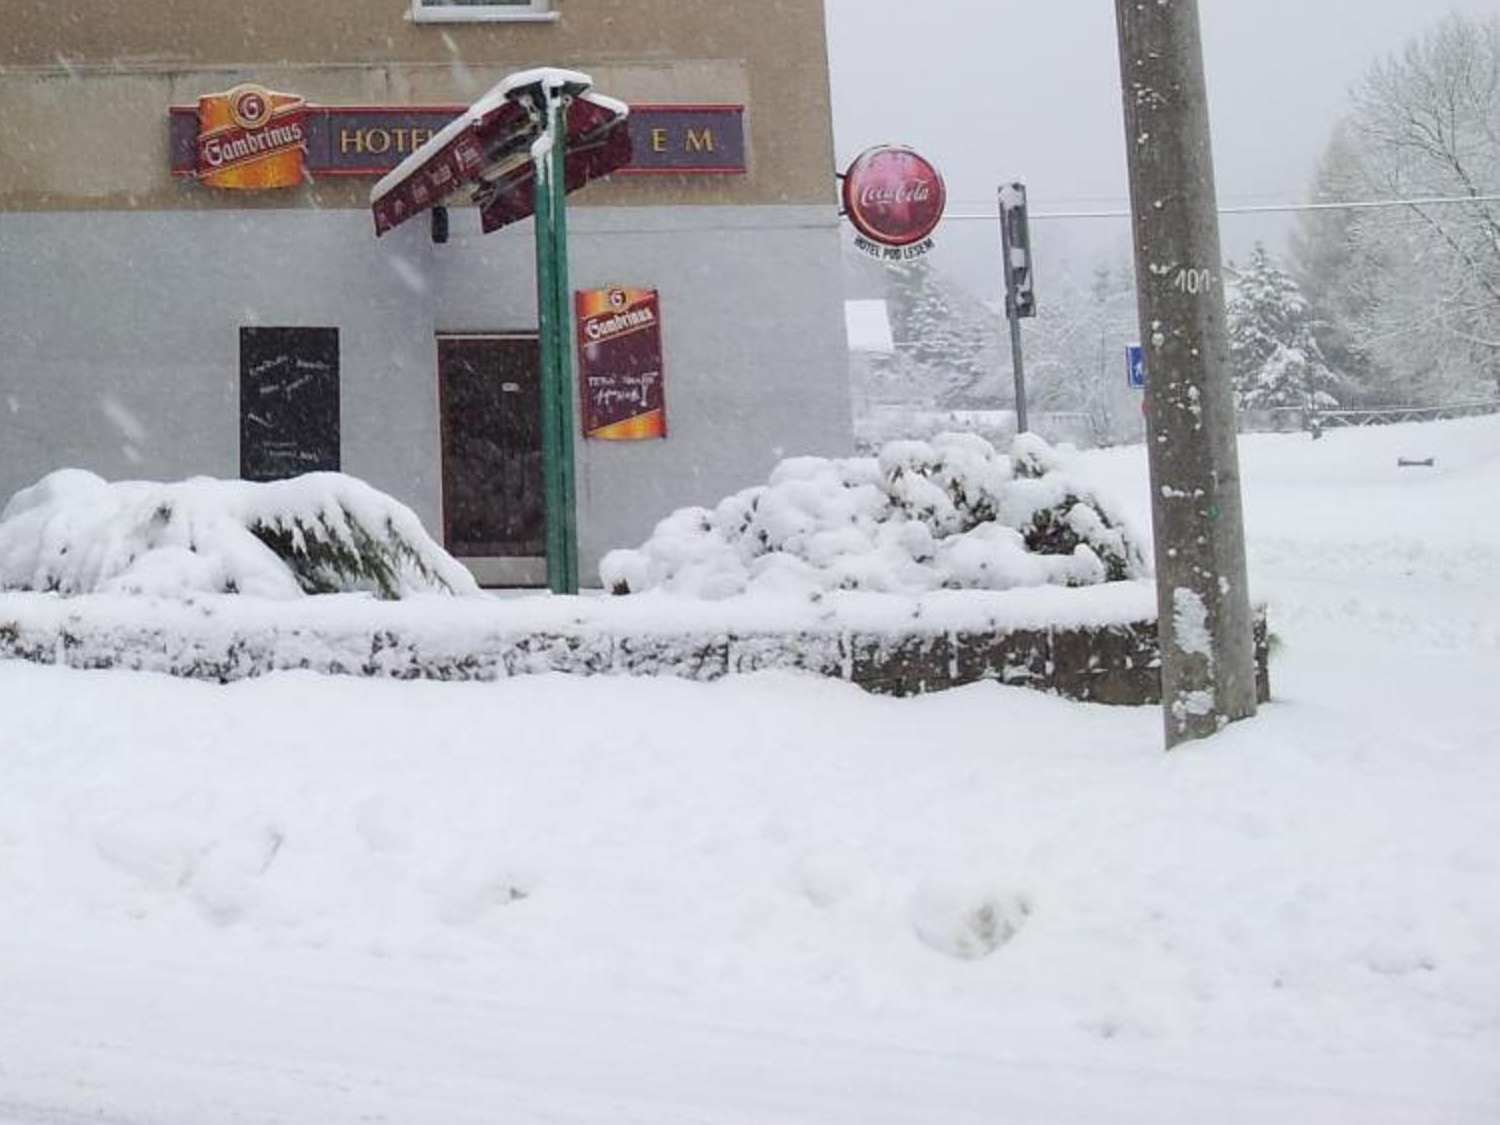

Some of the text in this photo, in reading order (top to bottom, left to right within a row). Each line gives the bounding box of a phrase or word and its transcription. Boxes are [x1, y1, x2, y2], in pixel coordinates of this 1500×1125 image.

[205, 122, 302, 166] Gambrinus
[853, 236, 880, 258] HOTEL
[1174, 268, 1211, 294] 101
[585, 307, 654, 339] Gambrinus
